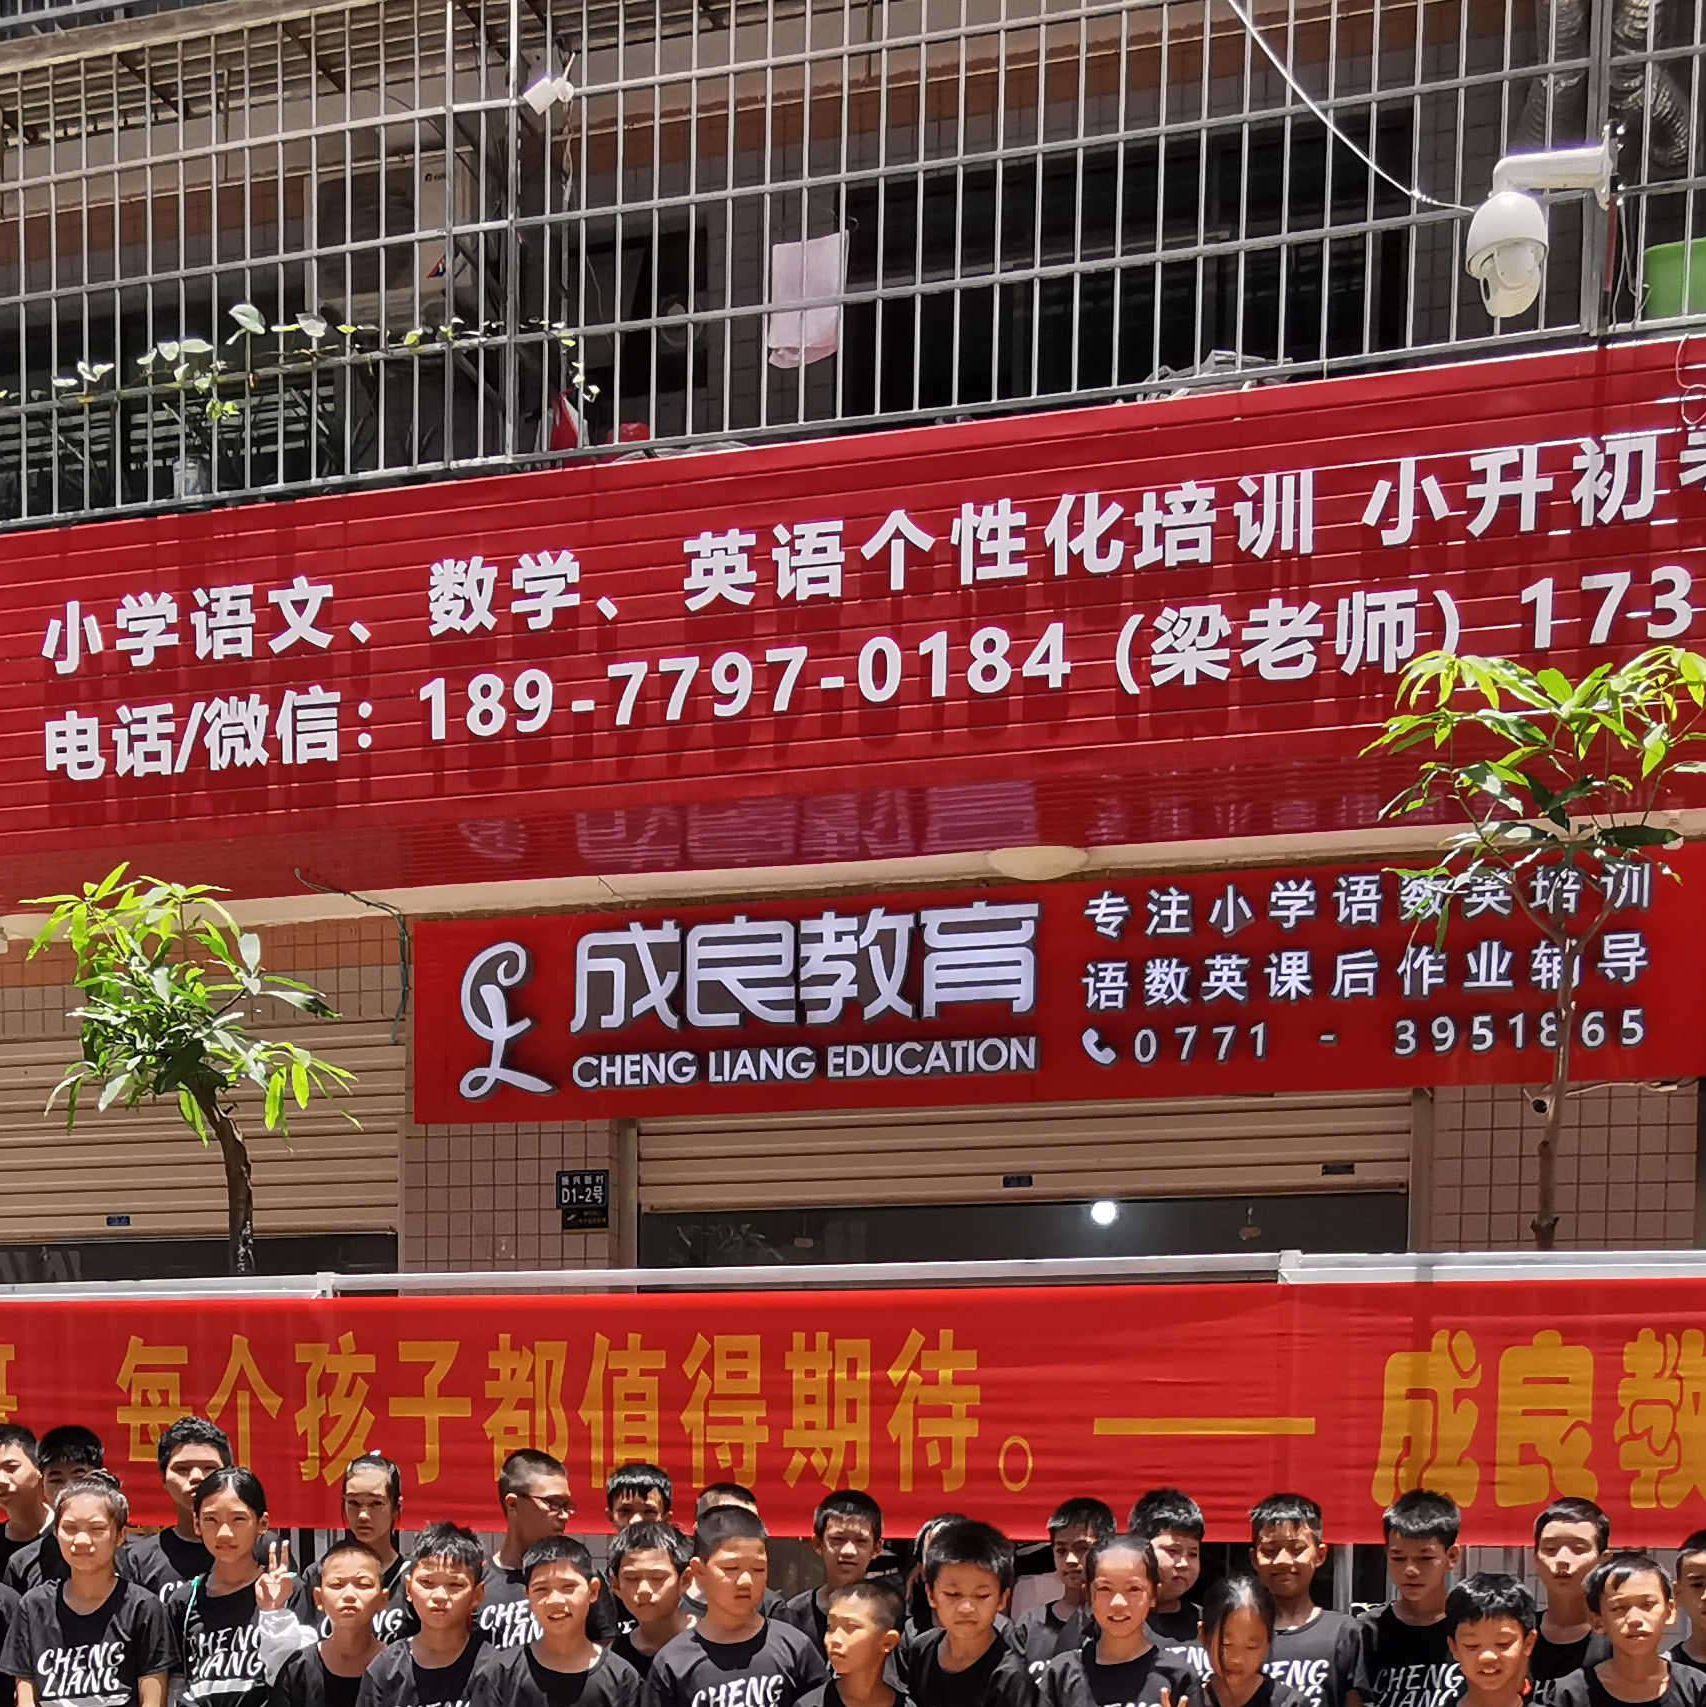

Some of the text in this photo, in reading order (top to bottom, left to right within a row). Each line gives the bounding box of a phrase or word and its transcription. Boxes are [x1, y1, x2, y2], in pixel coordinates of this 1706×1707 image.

[570, 898, 1043, 1034] 成良教育
[1081, 932, 1651, 1012] 语数英课后作业辅导
[570, 1036, 1038, 1090] CHENG LIANG EDUCATION
[561, 1185, 603, 1204] D1-2号
[37, 1641, 125, 1674] CHENG
[42, 1666, 121, 1697] LIANG
